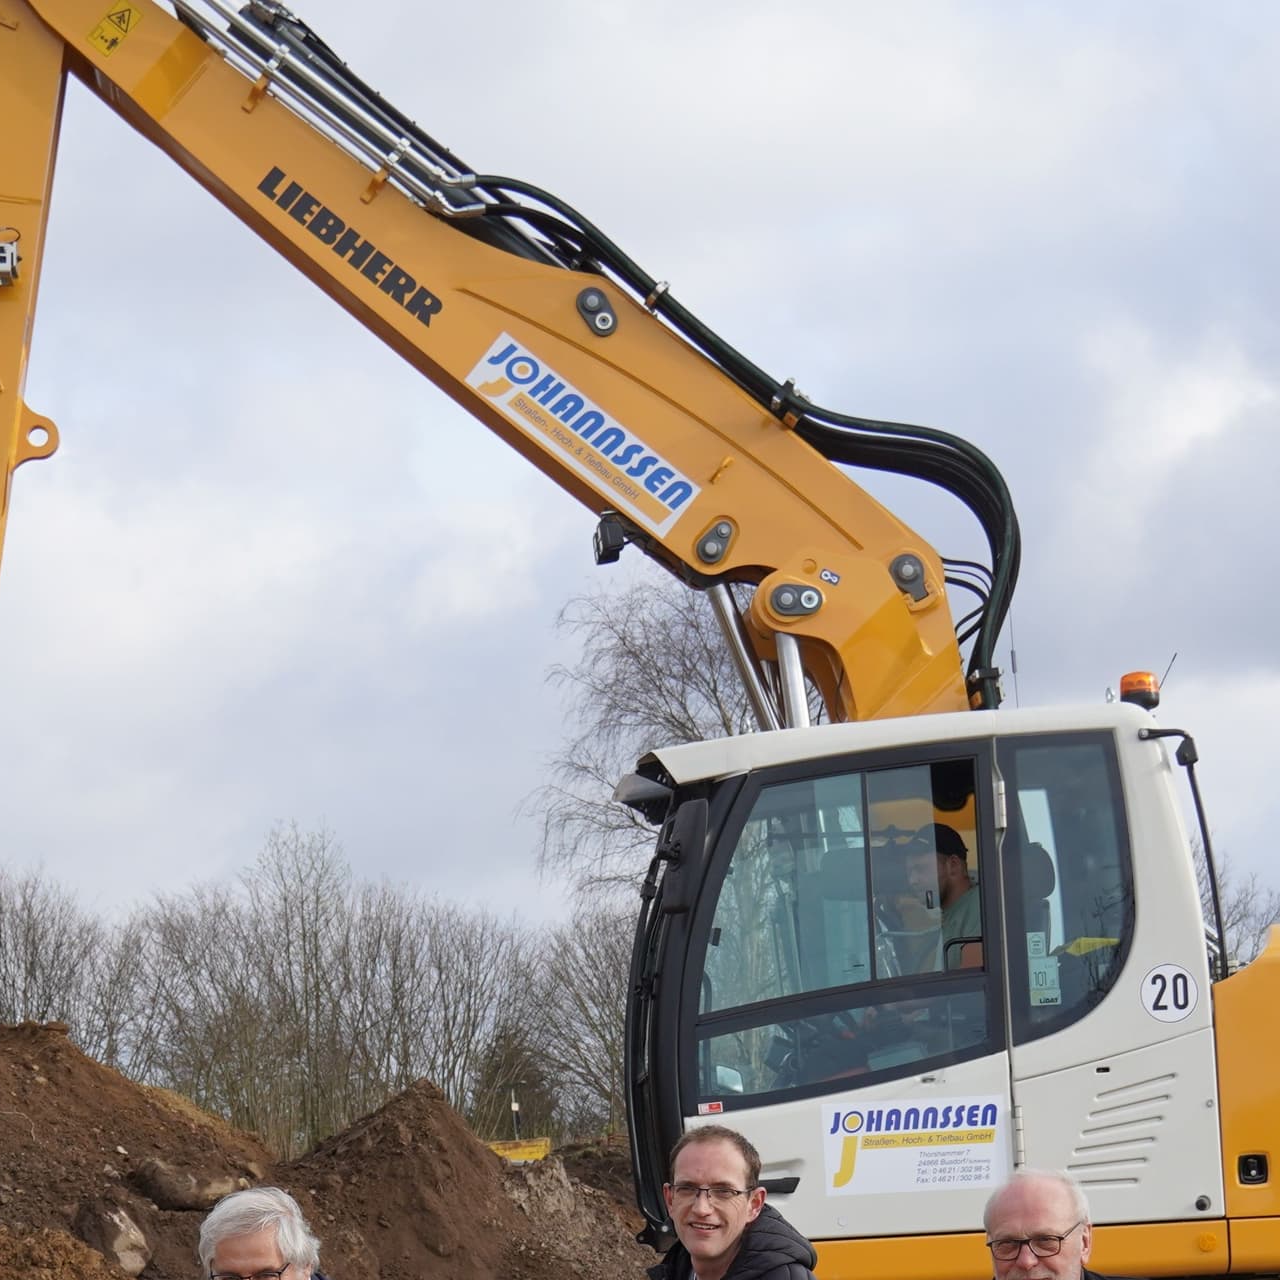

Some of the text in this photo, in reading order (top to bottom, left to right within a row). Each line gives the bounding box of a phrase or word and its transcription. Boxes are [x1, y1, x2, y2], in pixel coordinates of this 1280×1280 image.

[257, 166, 443, 328] LIEBHERR
[487, 343, 693, 511] JOHANNSSEN
[551, 426, 575, 450] Hoch-
[584, 452, 613, 480] Tiefbau
[612, 475, 640, 501] GmbH
[1151, 973, 1189, 1011] 20
[830, 1103, 998, 1135] JOHANNSSEN
[902, 1135, 926, 1144] Hoch-
[936, 1134, 964, 1143] Tiefbau
[966, 1132, 992, 1141] GmbH
